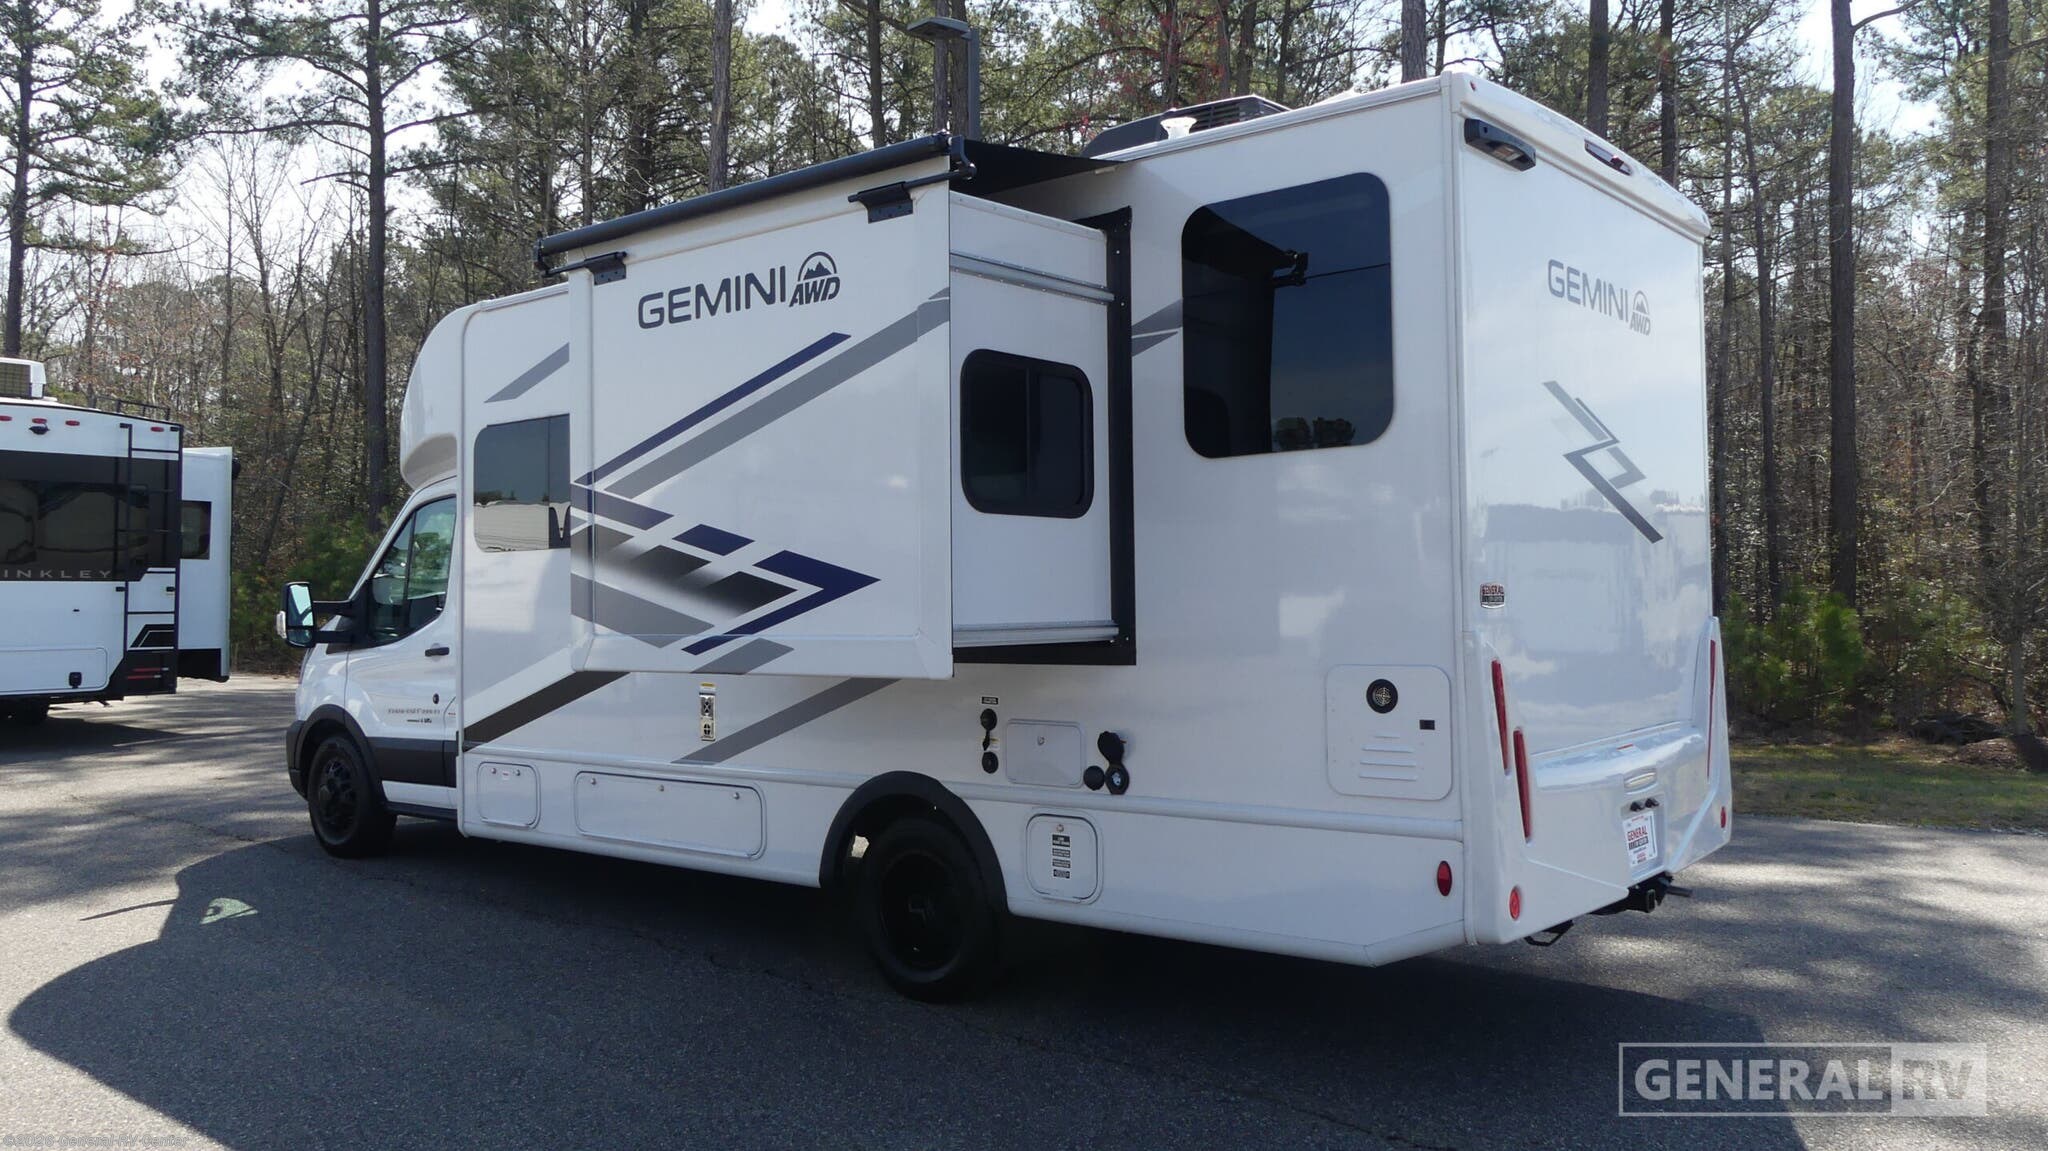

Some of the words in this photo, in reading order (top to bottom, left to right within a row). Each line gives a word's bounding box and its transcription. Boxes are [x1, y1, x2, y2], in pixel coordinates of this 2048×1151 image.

[637, 265, 786, 329] GEMINI
[789, 276, 841, 308] AWD
[1548, 258, 1629, 323] GEMINI
[1629, 311, 1651, 336] AWD
[3, 569, 112, 578] INKLEY
